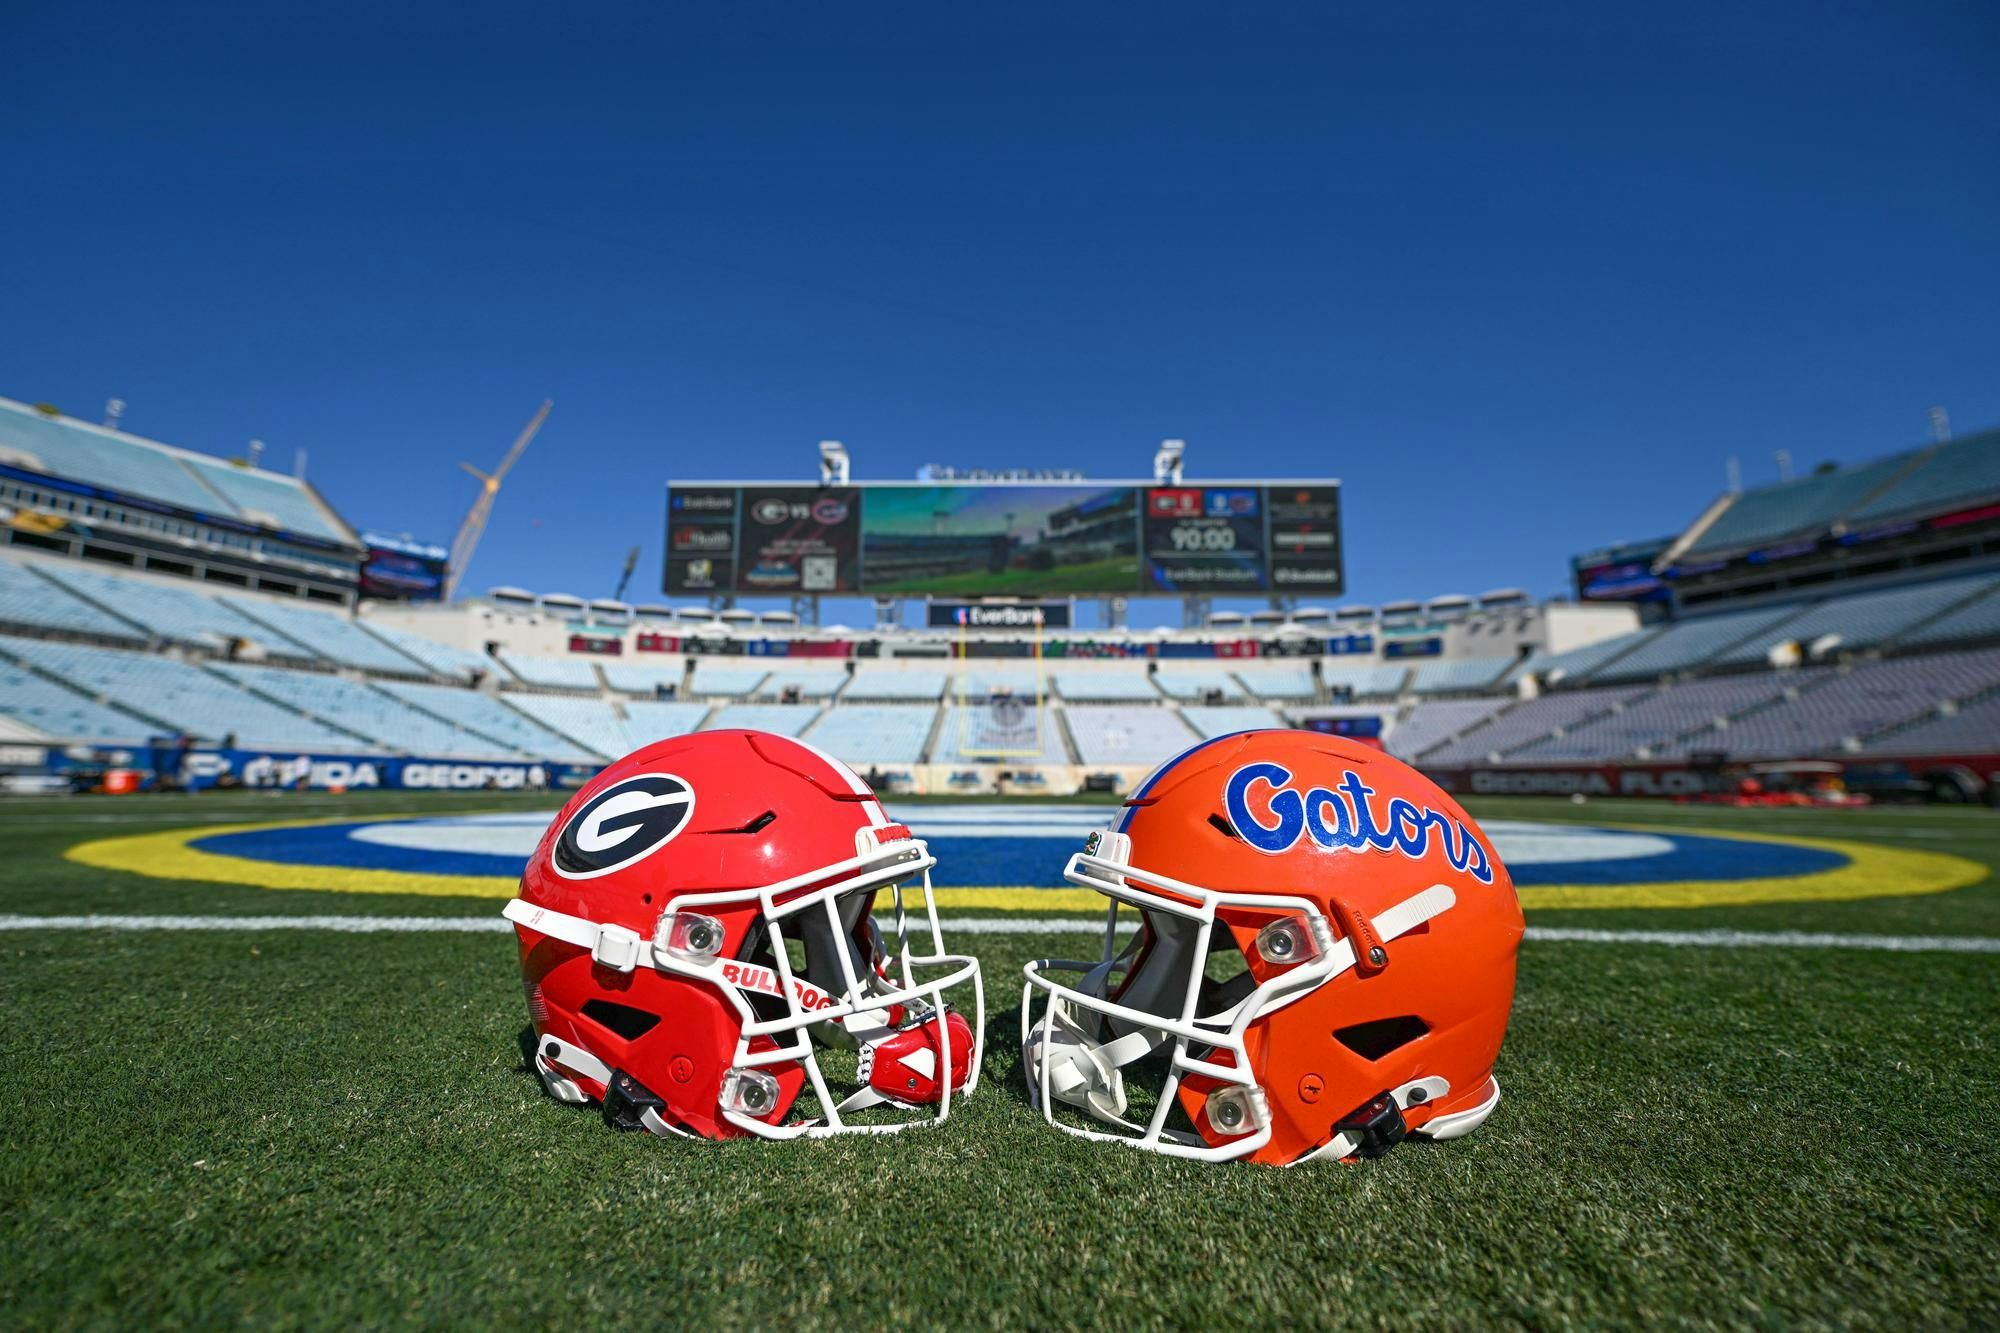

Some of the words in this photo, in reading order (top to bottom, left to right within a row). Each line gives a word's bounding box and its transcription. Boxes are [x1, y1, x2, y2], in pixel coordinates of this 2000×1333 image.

[1171, 527, 1236, 550] 90:00
[970, 606, 1044, 625] EverBank
[402, 764, 548, 789] GEORGI
[552, 773, 696, 880] G
[1225, 762, 1494, 885] Gators
